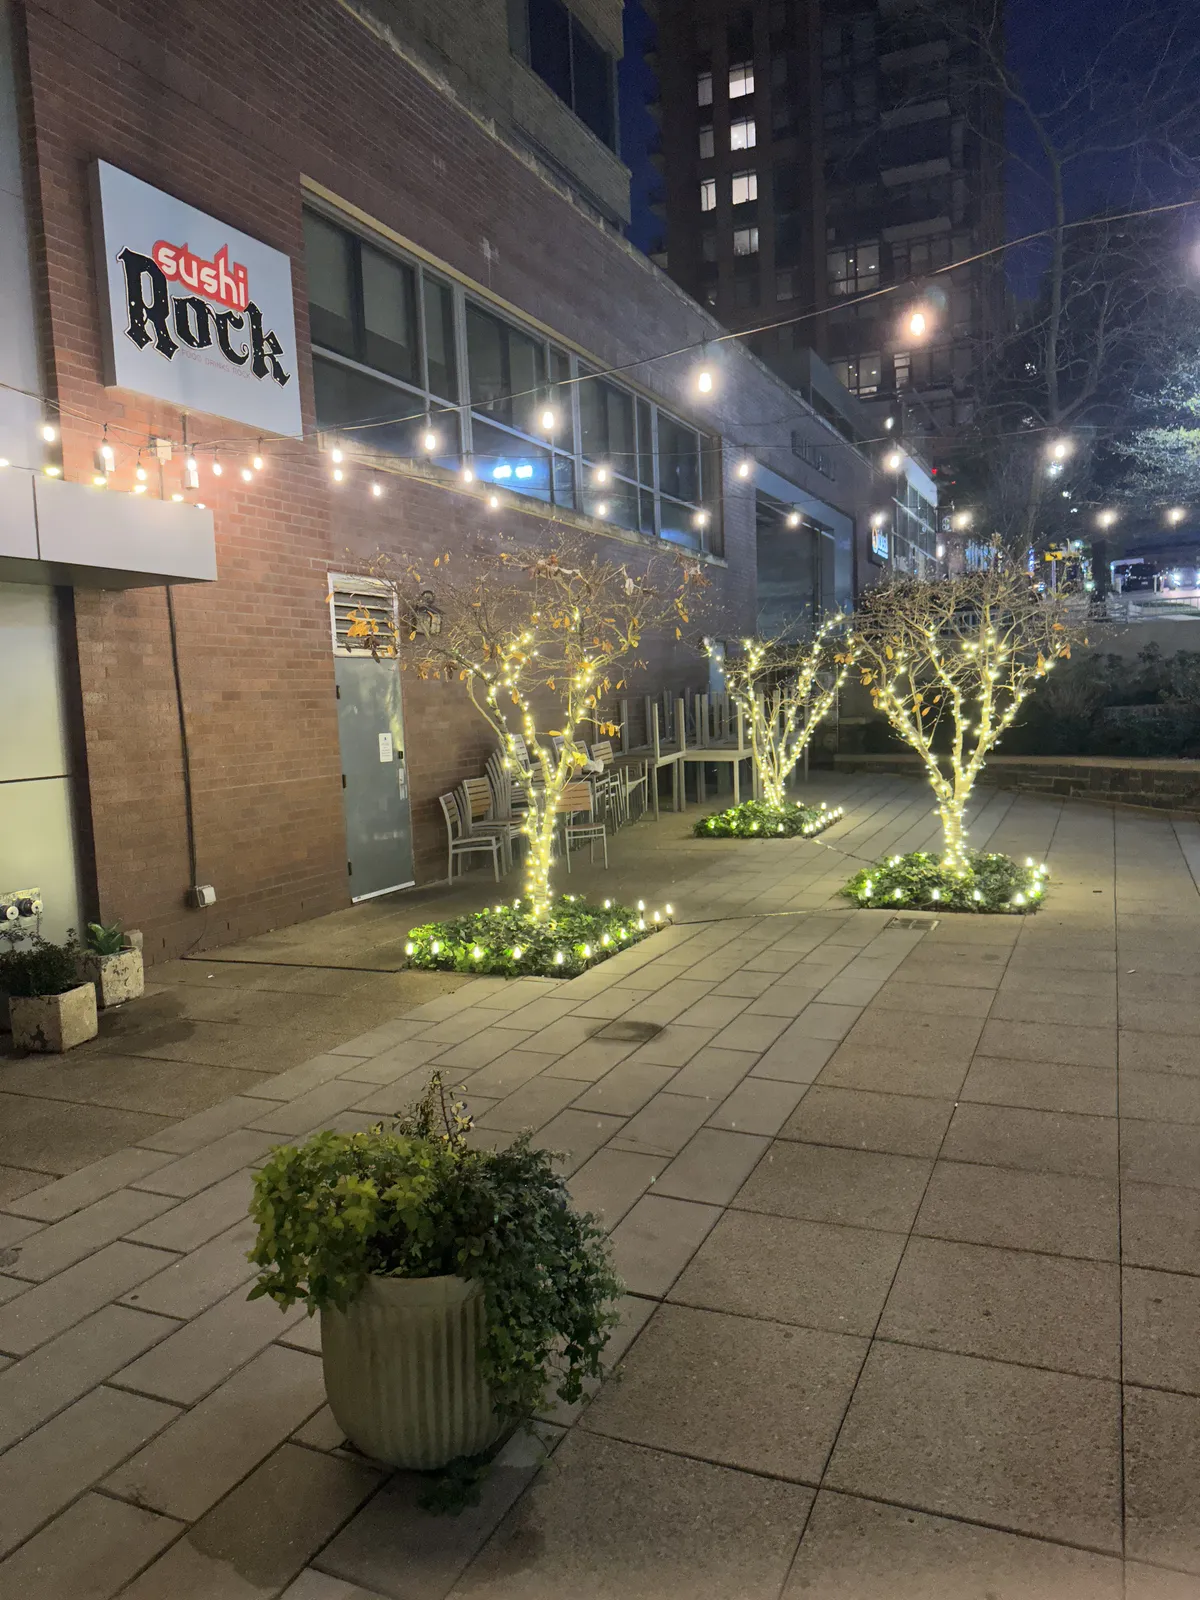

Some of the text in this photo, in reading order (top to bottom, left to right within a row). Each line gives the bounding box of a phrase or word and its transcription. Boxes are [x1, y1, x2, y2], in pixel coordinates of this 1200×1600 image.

[156, 245, 247, 308] sushi
[116, 247, 291, 387] Rock
[181, 348, 202, 362] FOOD
[205, 357, 230, 373] DRINKS
